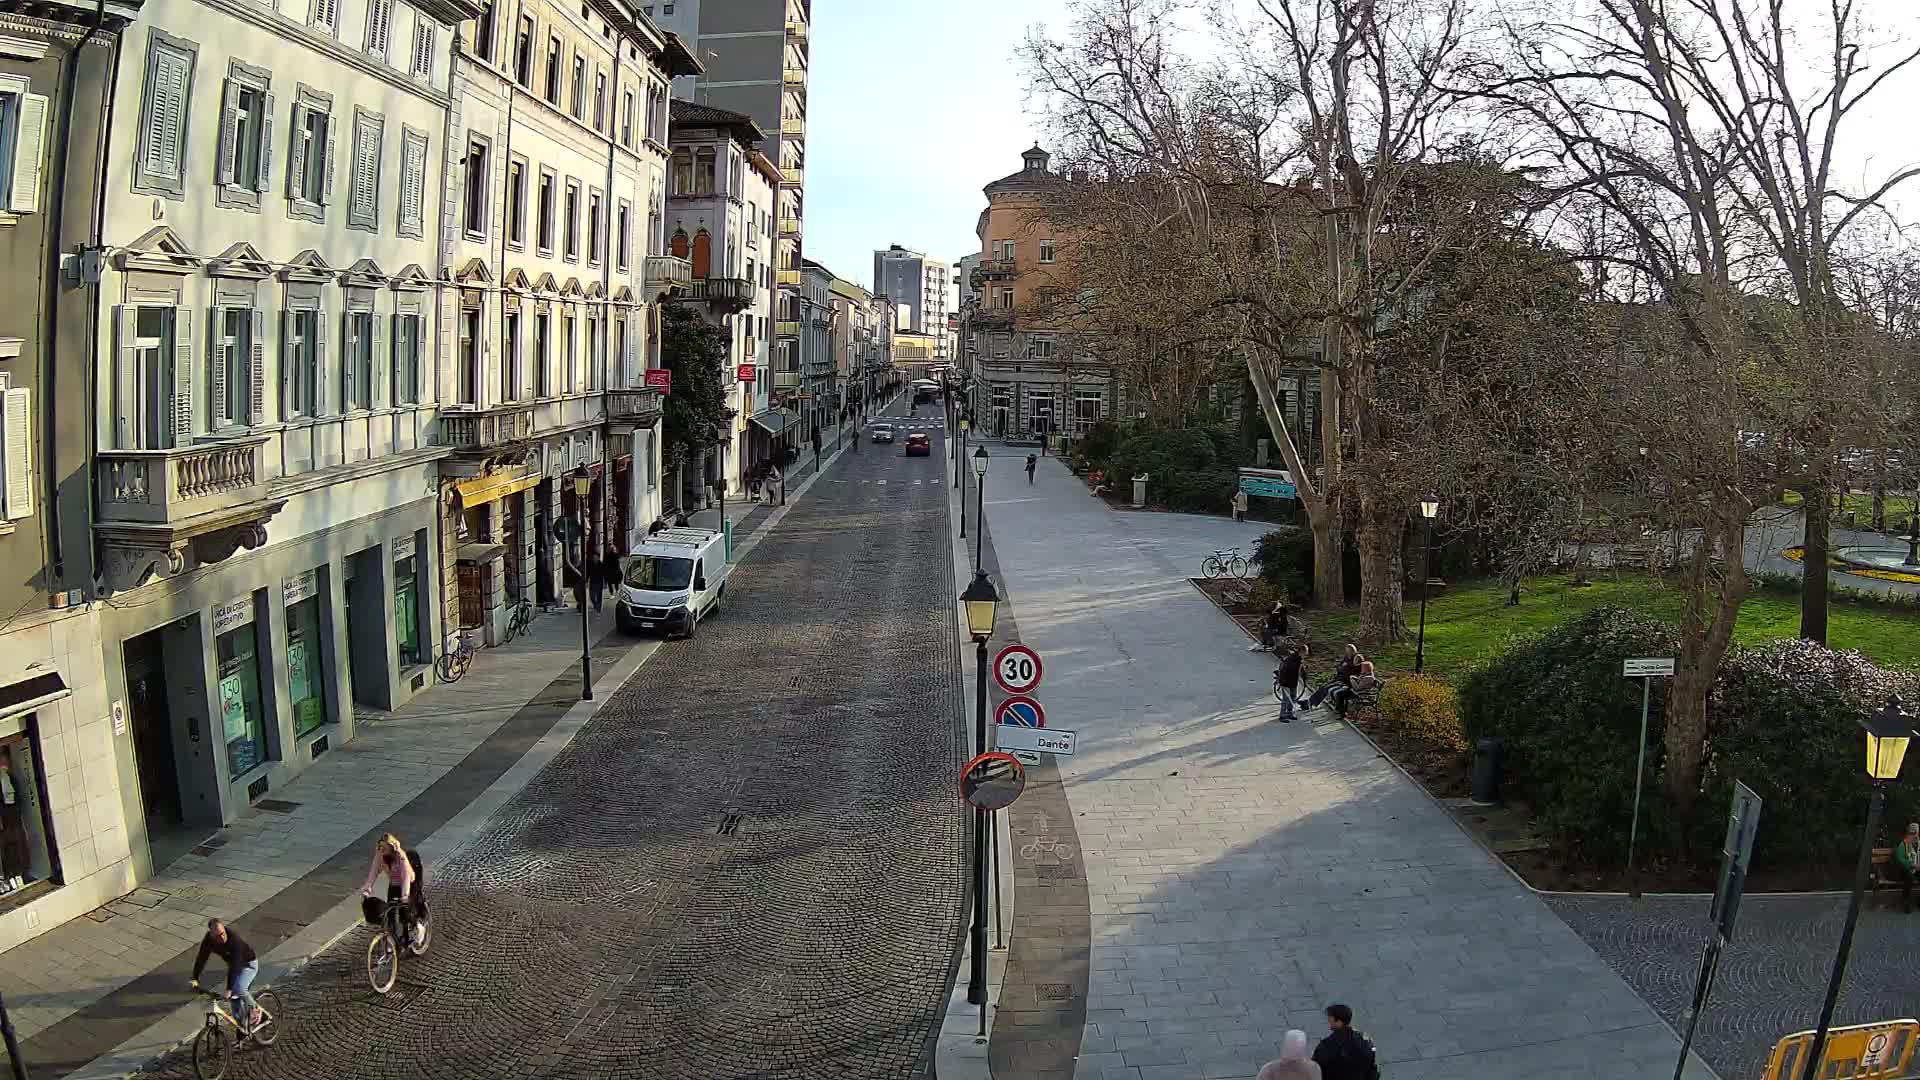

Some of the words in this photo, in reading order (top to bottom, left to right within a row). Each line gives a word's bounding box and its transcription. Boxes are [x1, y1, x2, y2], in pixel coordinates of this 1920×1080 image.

[1005, 659, 1033, 681] 30
[223, 678, 240, 700] 130
[1038, 738, 1069, 750] Dante
